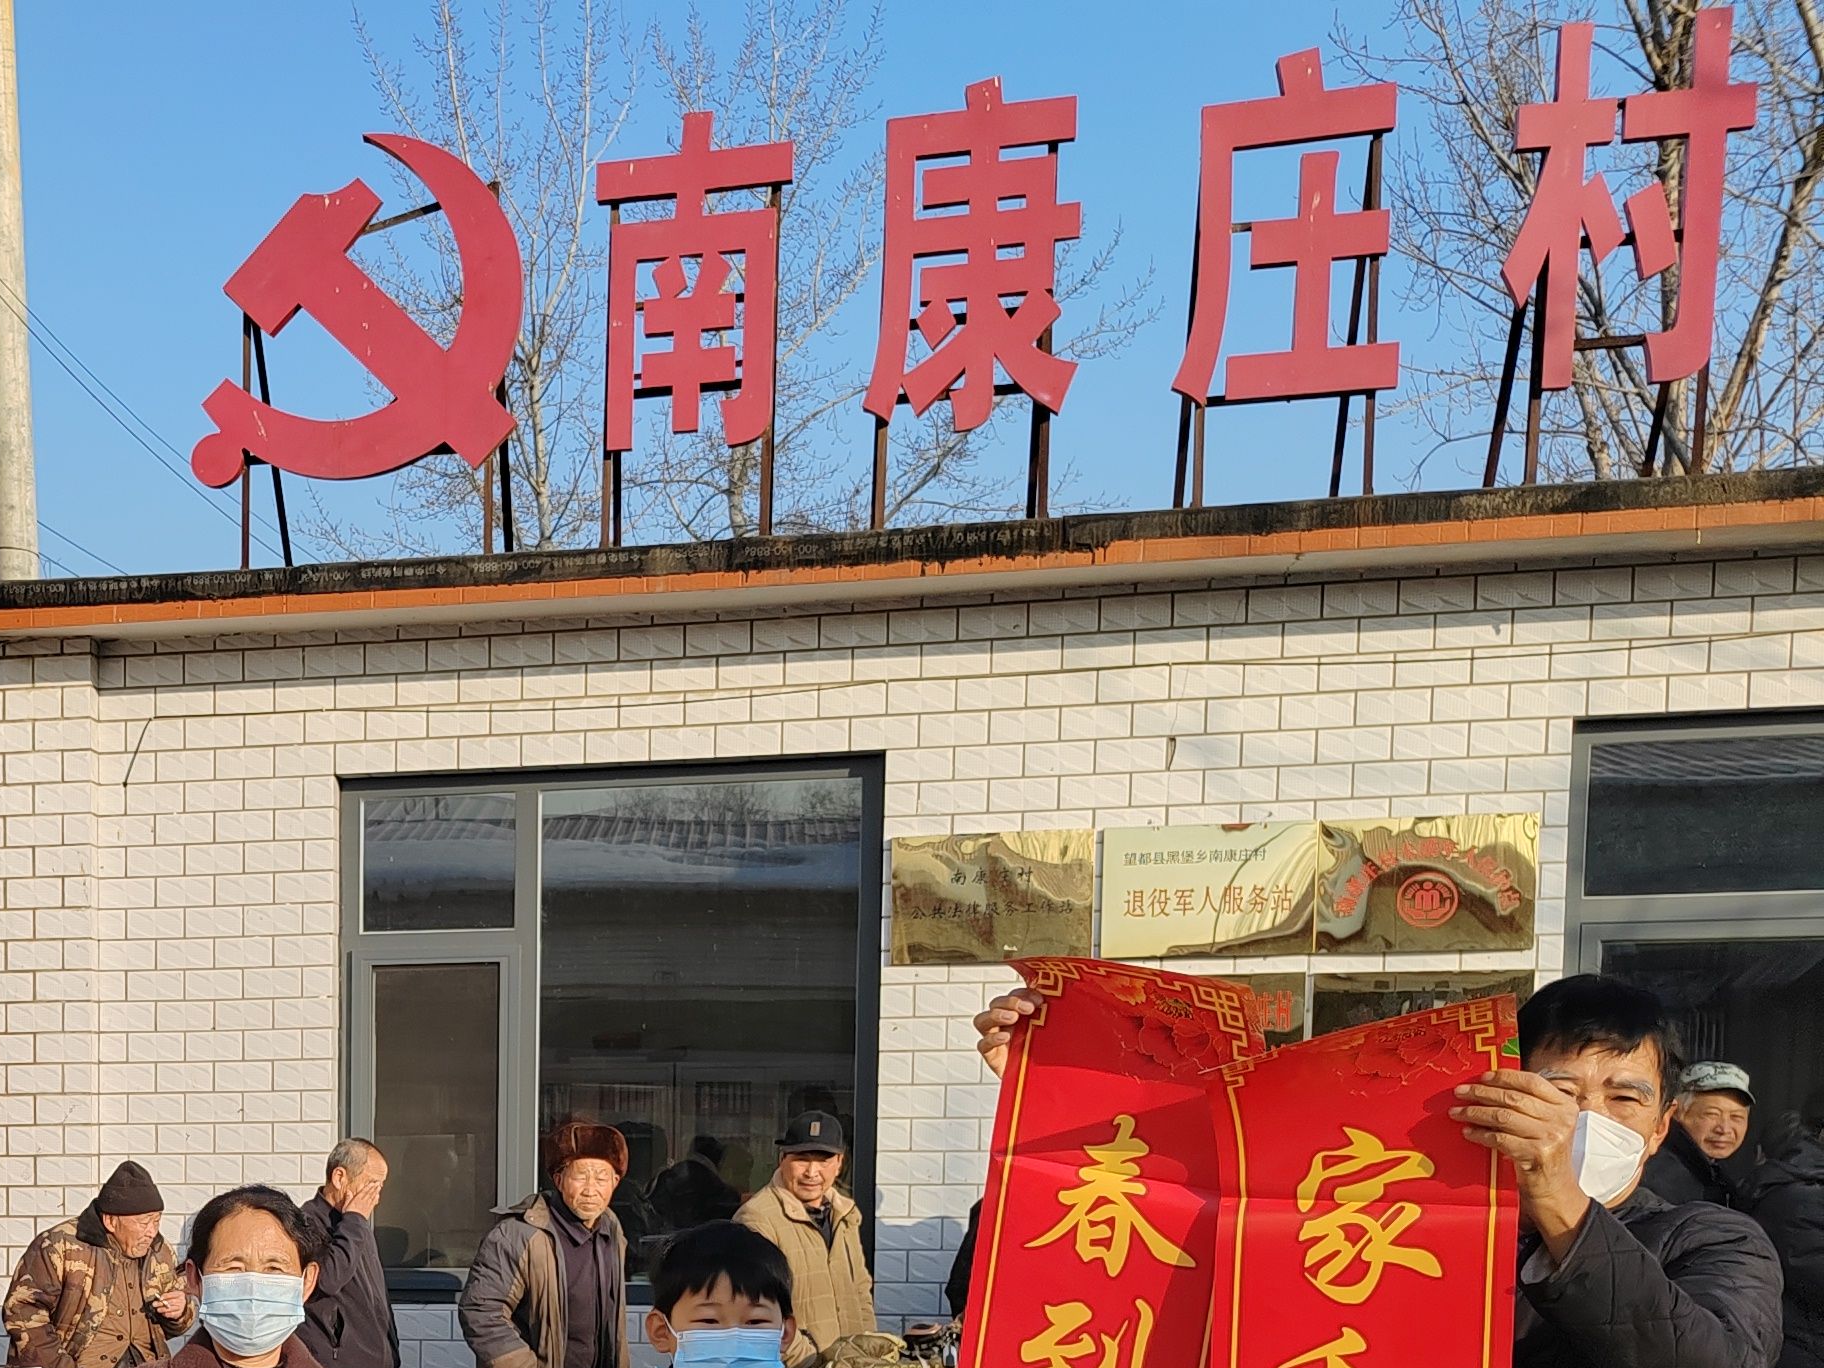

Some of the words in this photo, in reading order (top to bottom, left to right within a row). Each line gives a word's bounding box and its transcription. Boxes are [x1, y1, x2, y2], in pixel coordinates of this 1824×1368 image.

[596, 6, 1757, 454] 南康庄村
[1124, 848, 1267, 866] 望都县黑堡乡南康庄村
[950, 866, 1033, 886] 南康庄村
[911, 901, 1074, 919] 公共法律服务工作站
[1123, 884, 1294, 918] 退役军人服务站
